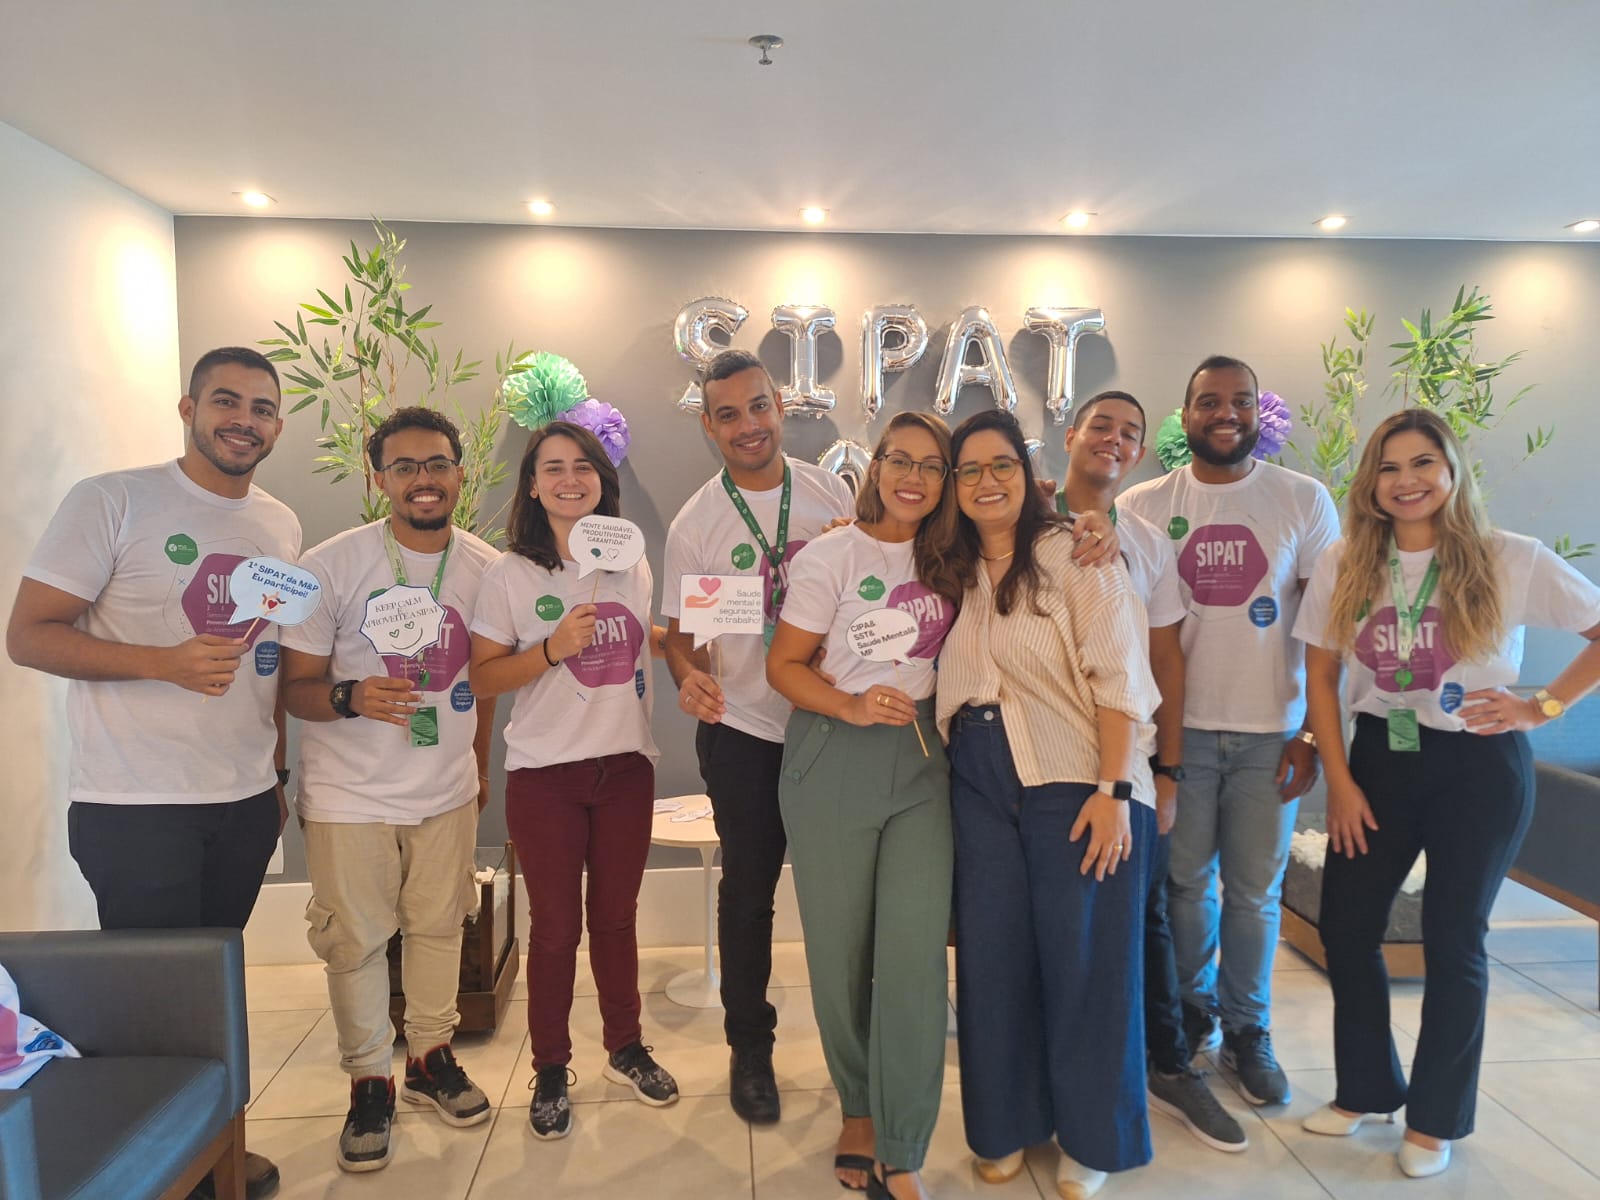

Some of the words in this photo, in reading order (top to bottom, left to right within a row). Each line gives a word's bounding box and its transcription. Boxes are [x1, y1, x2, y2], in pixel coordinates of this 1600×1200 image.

[673, 296, 1105, 425] SIPAT
[1195, 540, 1247, 567] SIPAT
[251, 572, 263, 582] Eu
[258, 565, 287, 580] SIPAT
[286, 576, 297, 585] da
[298, 579, 319, 592] M&P
[375, 602, 397, 613] KEEP
[397, 595, 422, 608] CALM
[719, 608, 761, 617] segurança
[1374, 621, 1438, 652] SIAT
